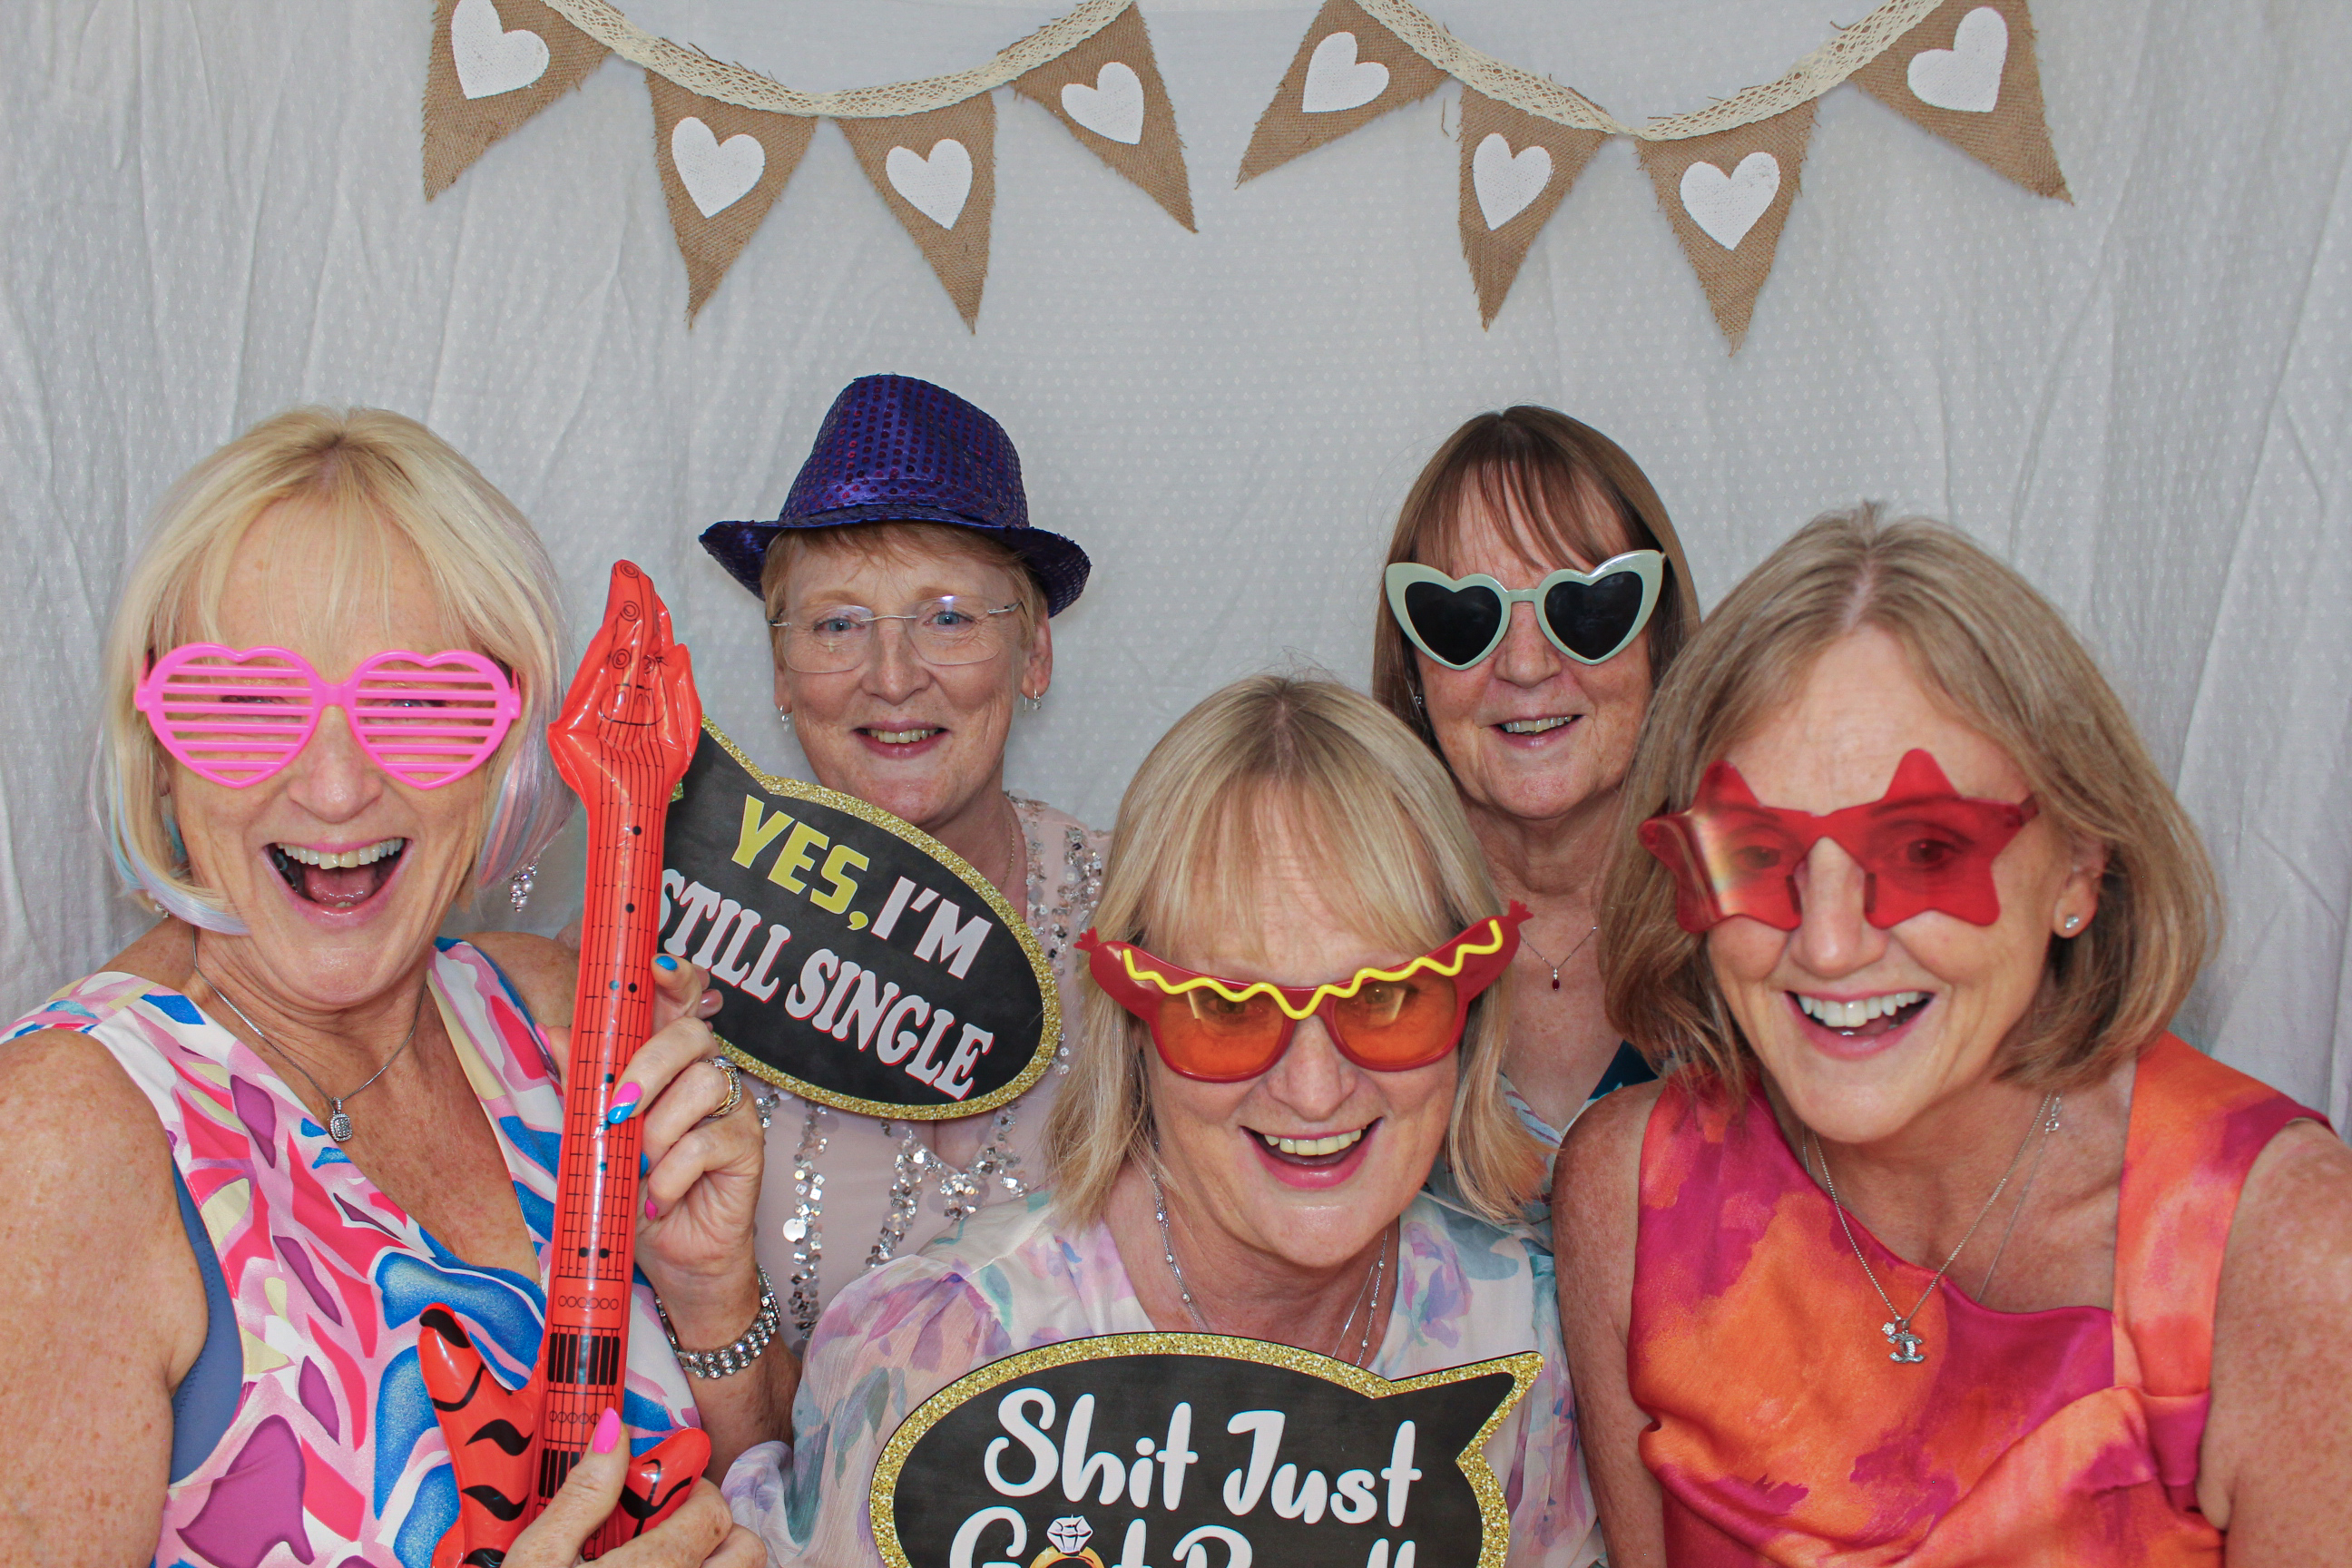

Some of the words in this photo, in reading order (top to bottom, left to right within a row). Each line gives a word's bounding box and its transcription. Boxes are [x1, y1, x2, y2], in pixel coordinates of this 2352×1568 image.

[731, 794, 869, 930] YES,
[871, 876, 992, 979] I'M
[784, 948, 995, 1101] SINGLE
[985, 1387, 1199, 1511] Shit
[1223, 1409, 1422, 1528] Just
